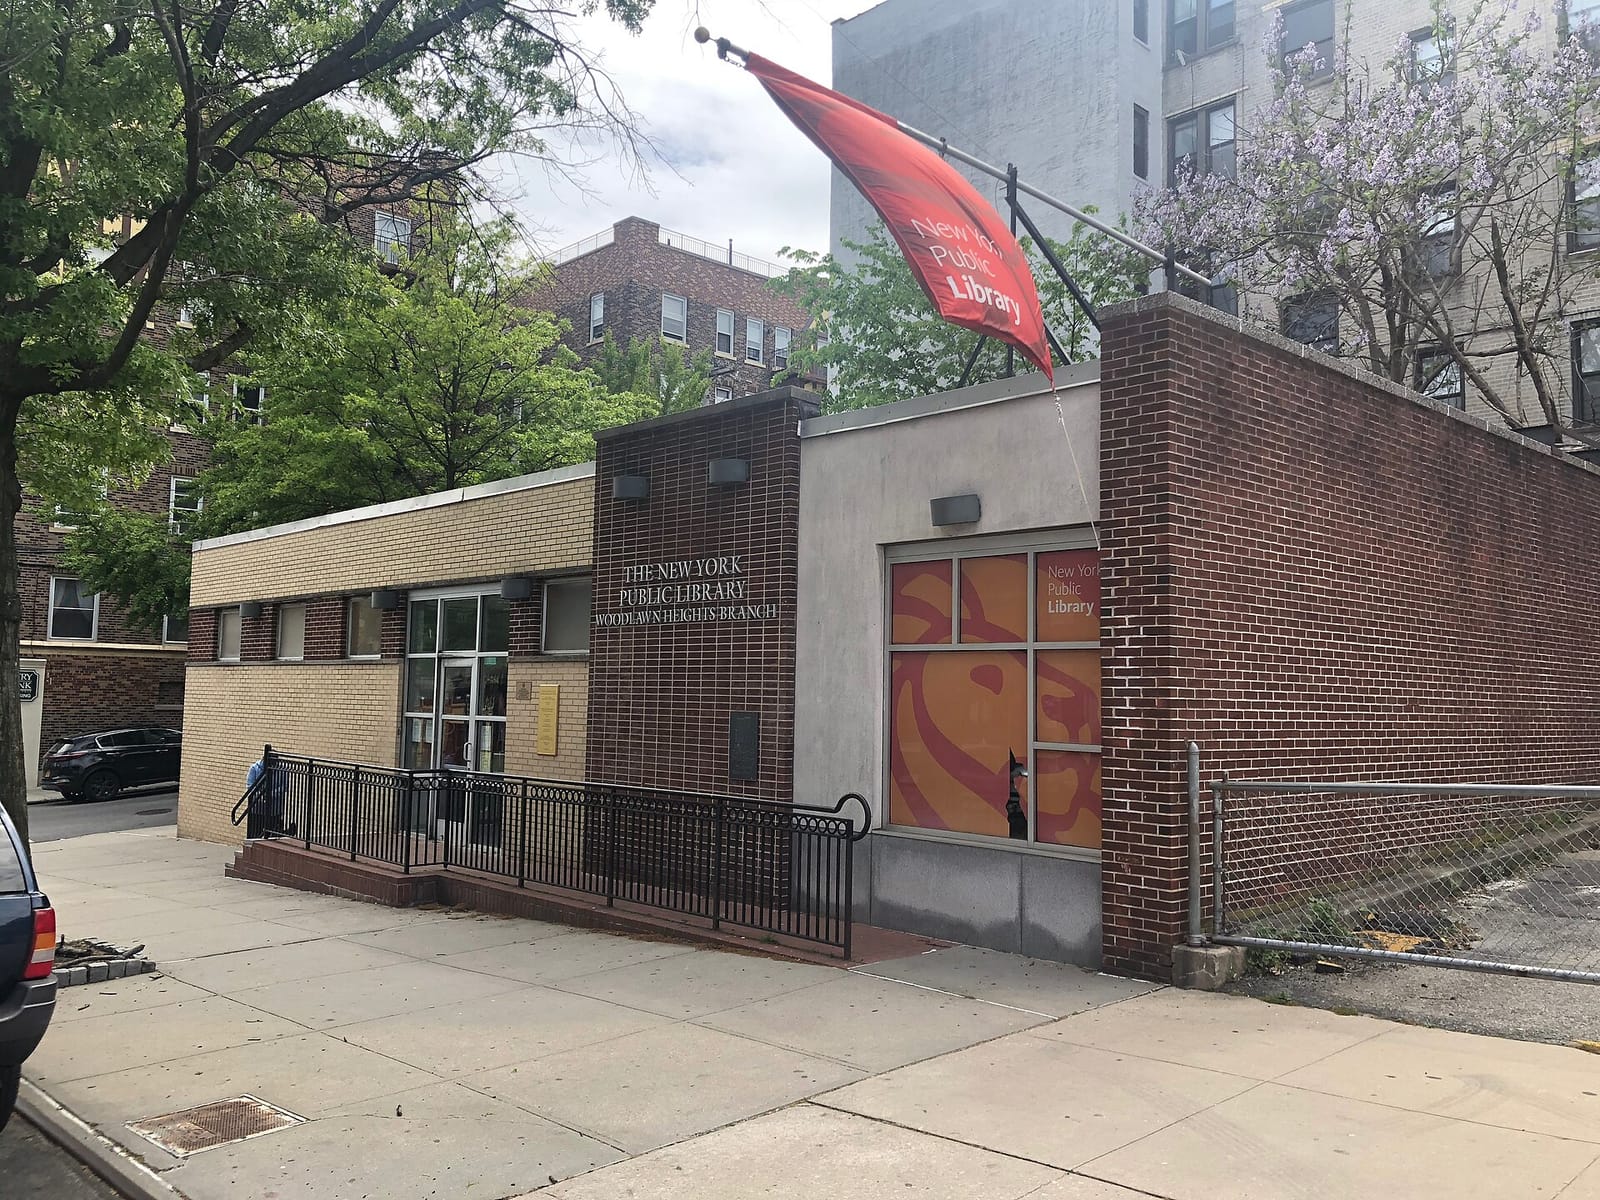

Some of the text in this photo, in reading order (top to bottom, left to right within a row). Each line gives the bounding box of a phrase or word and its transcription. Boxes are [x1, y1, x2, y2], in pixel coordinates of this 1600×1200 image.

[910, 217, 968, 242] New
[929, 245, 996, 277] Public
[946, 274, 1020, 325] Library
[624, 555, 743, 583] THE NEW YORK
[1048, 565, 1075, 579] New
[619, 580, 746, 607] PUBLIC LIBRARY
[1048, 580, 1081, 596] Public
[595, 603, 777, 626] WOODLAWN HEIGHTS BRANCH
[1048, 599, 1094, 617] Library
